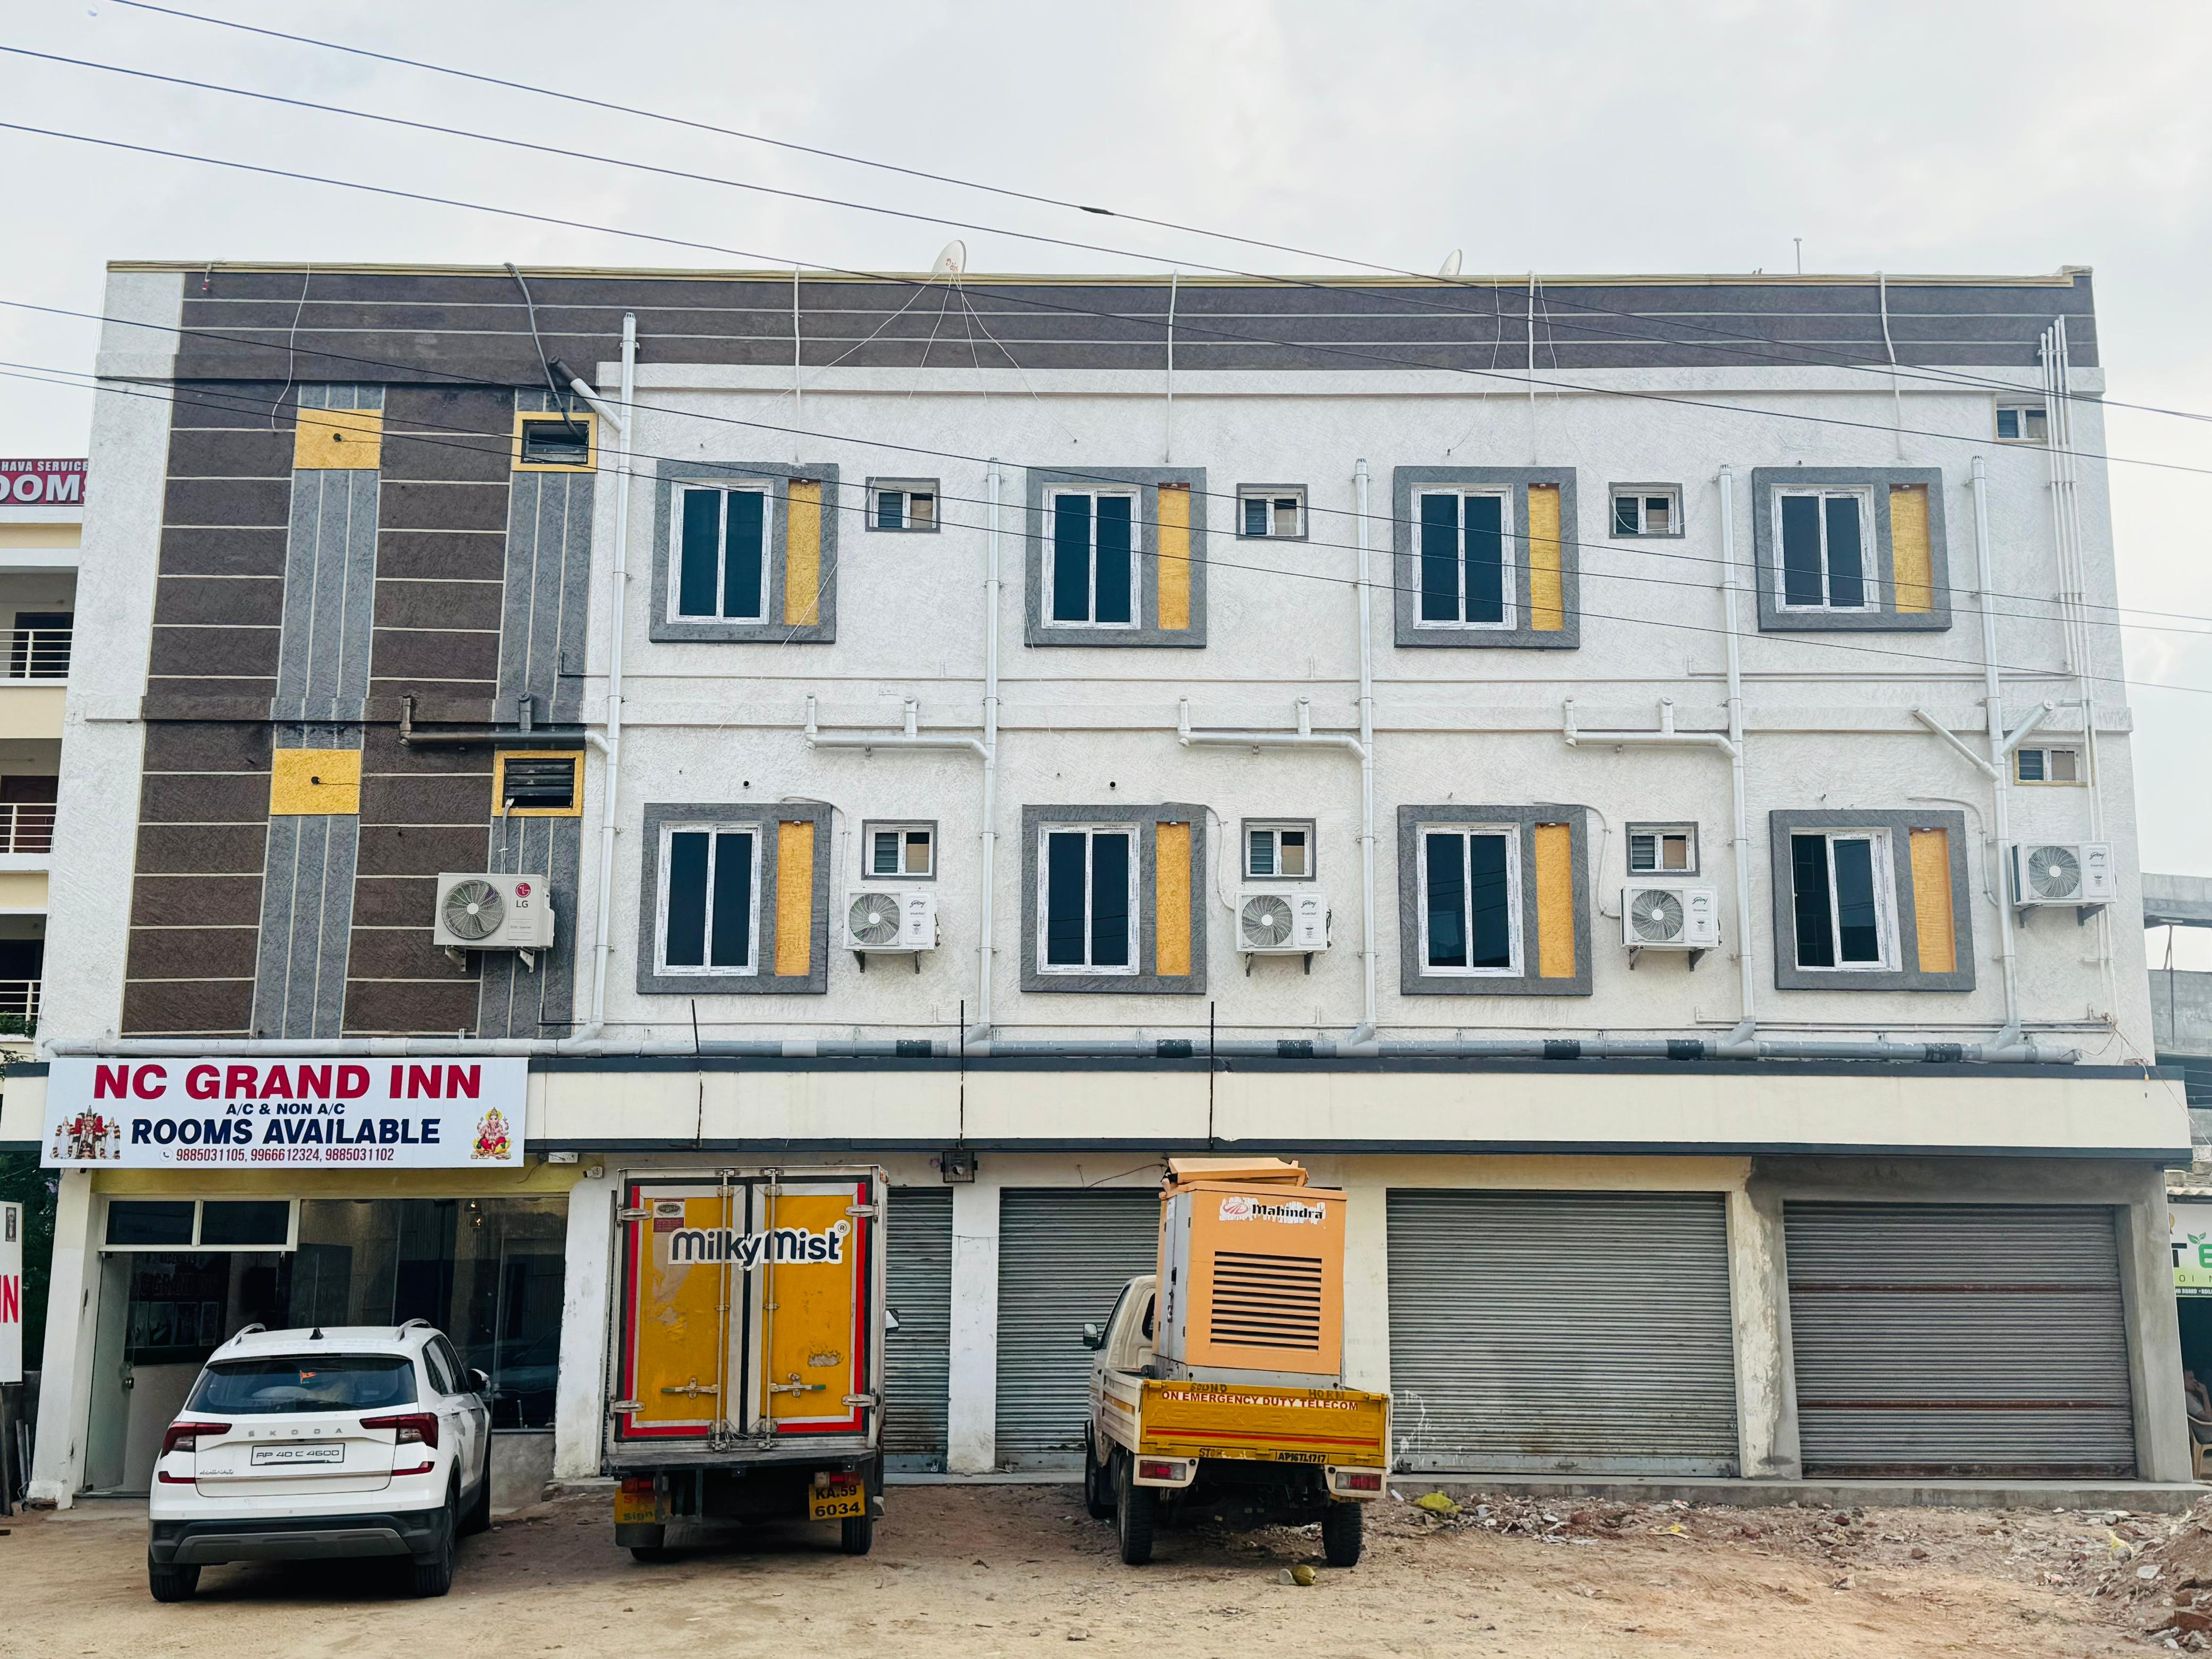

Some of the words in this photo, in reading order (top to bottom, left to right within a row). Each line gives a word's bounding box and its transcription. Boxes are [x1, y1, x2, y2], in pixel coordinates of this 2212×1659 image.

[0, 461, 33, 472] HAVA
[37, 461, 88, 472] SERVICE
[0, 474, 86, 501] OM
[94, 1064, 167, 1100] NC
[186, 1064, 371, 1100] GRAND
[389, 1065, 481, 1099] INN
[226, 1103, 254, 1116] A/C
[258, 1103, 271, 1115] &
[276, 1103, 312, 1115] NON
[317, 1103, 345, 1116] A/C
[131, 1118, 253, 1145] ROOMS
[263, 1118, 441, 1144] AVAILABLE
[176, 1148, 247, 1162] 9885031105,
[251, 1148, 322, 1162] 9966612324,
[325, 1148, 394, 1161] 9885031102
[1252, 1204, 1323, 1220] Mahindra
[0, 1275, 18, 1323] N
[1162, 1391, 1179, 1400] ON
[1183, 1392, 1259, 1405] EMERGENCY
[1263, 1397, 1295, 1407] DUTY
[1300, 1400, 1358, 1411] TELECOM
[1309, 1389, 1345, 1401] HORN
[815, 1502, 860, 1517] 6034
